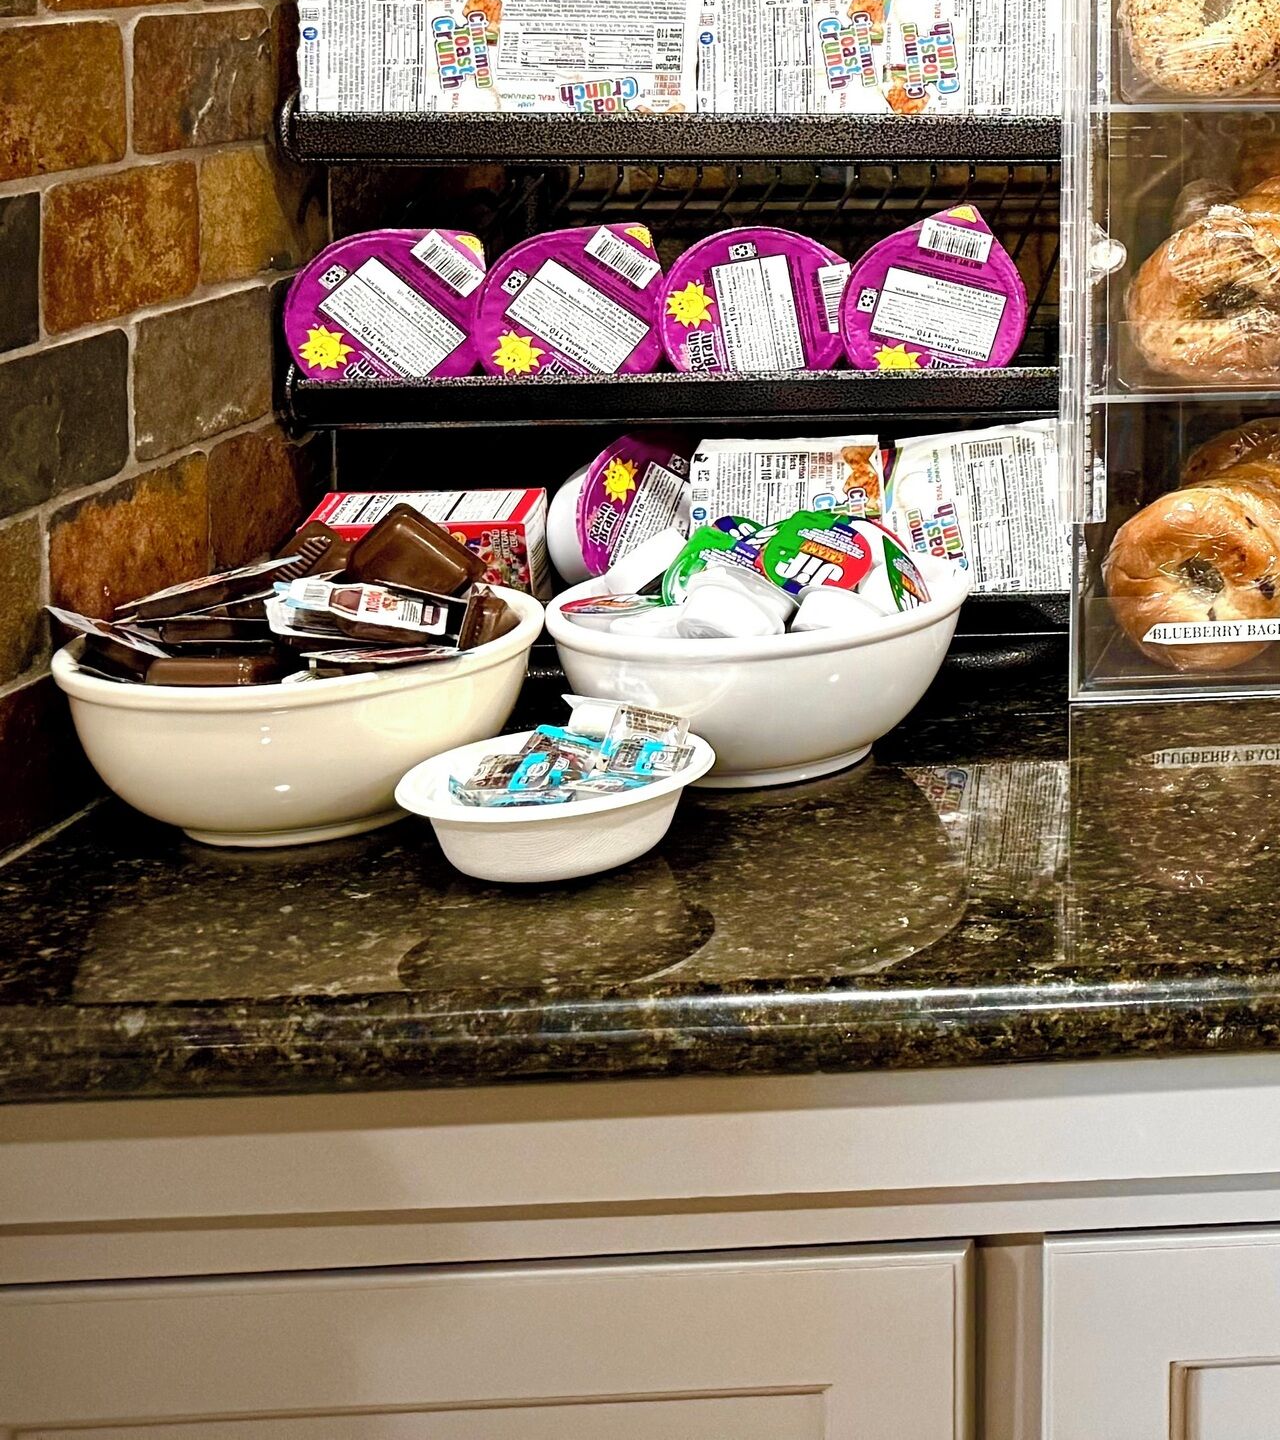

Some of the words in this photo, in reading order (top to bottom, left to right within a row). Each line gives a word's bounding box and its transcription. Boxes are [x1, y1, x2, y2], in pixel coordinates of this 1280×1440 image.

[432, 17, 465, 90] Crunch
[453, 27, 477, 76] Toast
[468, 12, 492, 88] Cinnamon
[819, 18, 852, 90] Crunch
[839, 27, 863, 75] Toast
[852, 11, 877, 87] Cinnamon
[901, 23, 924, 98] Cinnamon
[917, 36, 939, 83] Toast
[930, 21, 960, 92] Crunch
[559, 77, 637, 104] Crunch
[687, 331, 707, 371] Raisin
[701, 333, 718, 369] Bran
[589, 502, 612, 544] Raisin
[600, 509, 619, 546] Bran
[922, 518, 946, 557] oast
[932, 503, 968, 570] runch
[774, 551, 845, 587] Jif
[1151, 624, 1243, 641] BLUEBERRY
